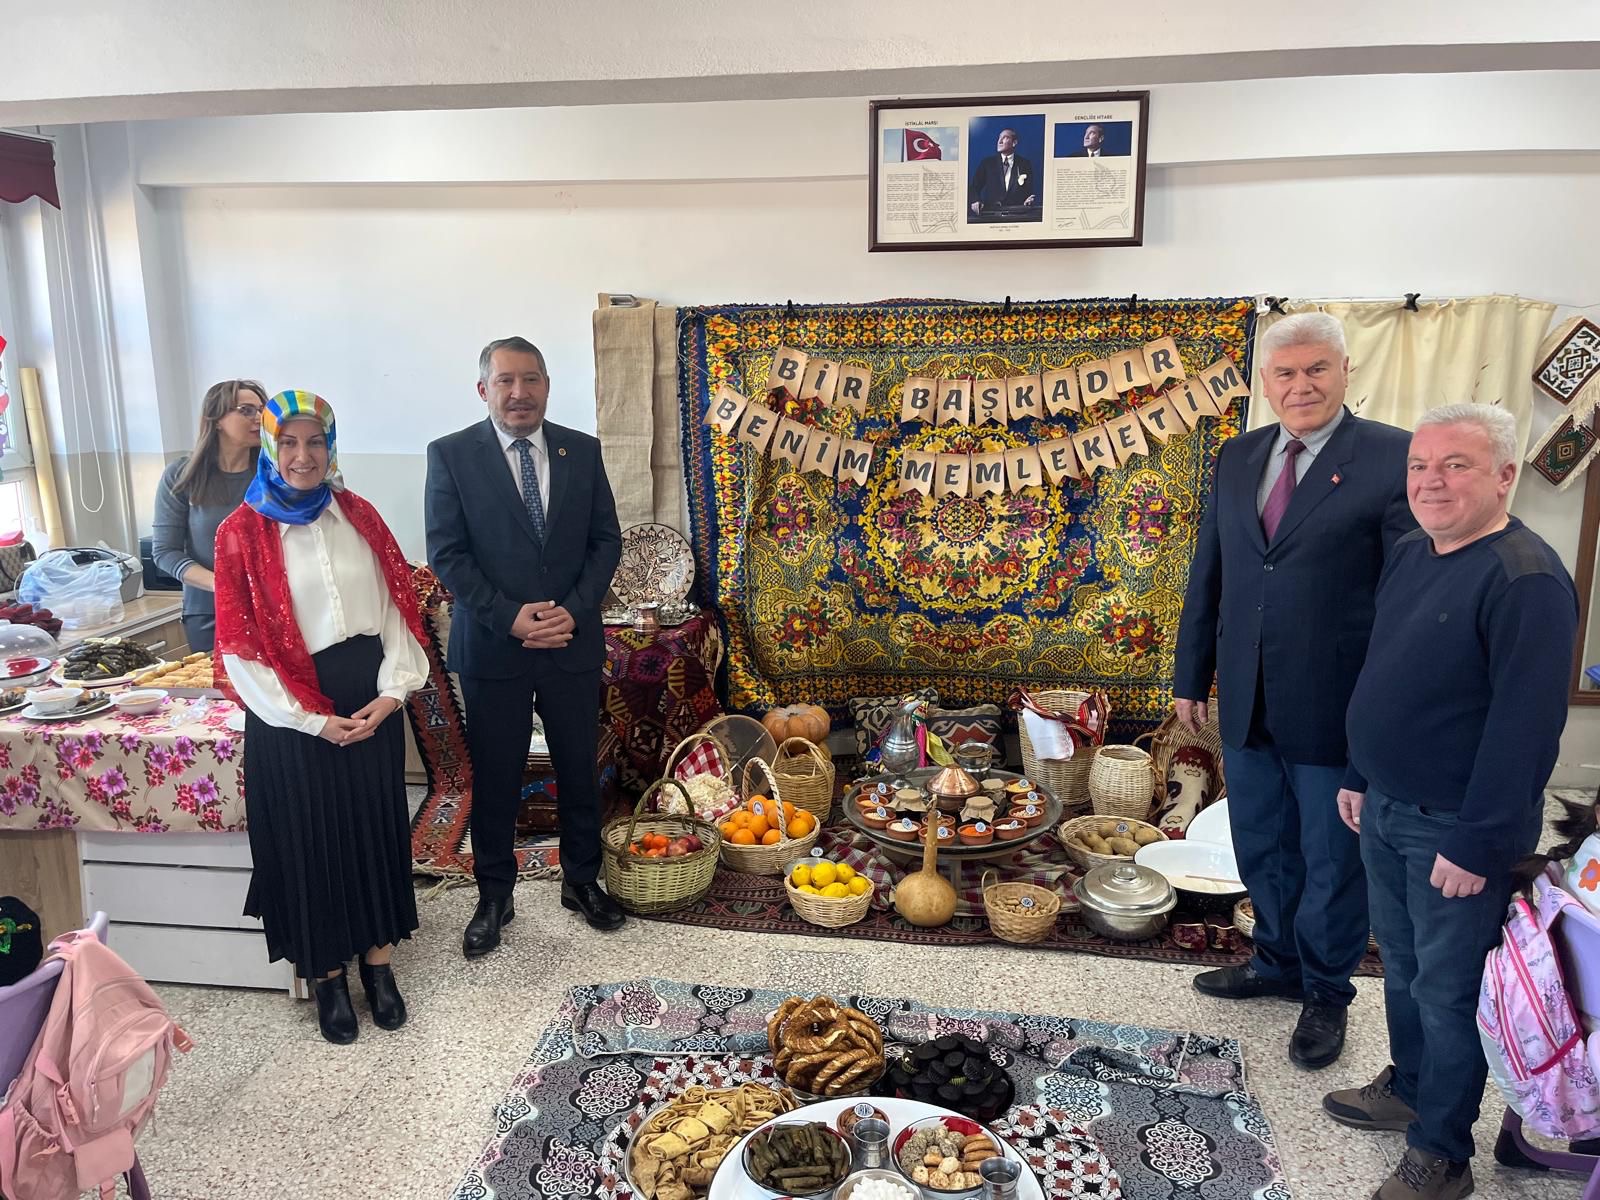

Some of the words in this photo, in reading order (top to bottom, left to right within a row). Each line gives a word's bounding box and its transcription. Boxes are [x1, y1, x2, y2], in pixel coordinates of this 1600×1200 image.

[717, 397, 870, 474] BENİM
[903, 367, 1238, 485] MEMLEKETİM
[779, 357, 861, 401] BİR
[910, 348, 1174, 418] BAŞKADIR
